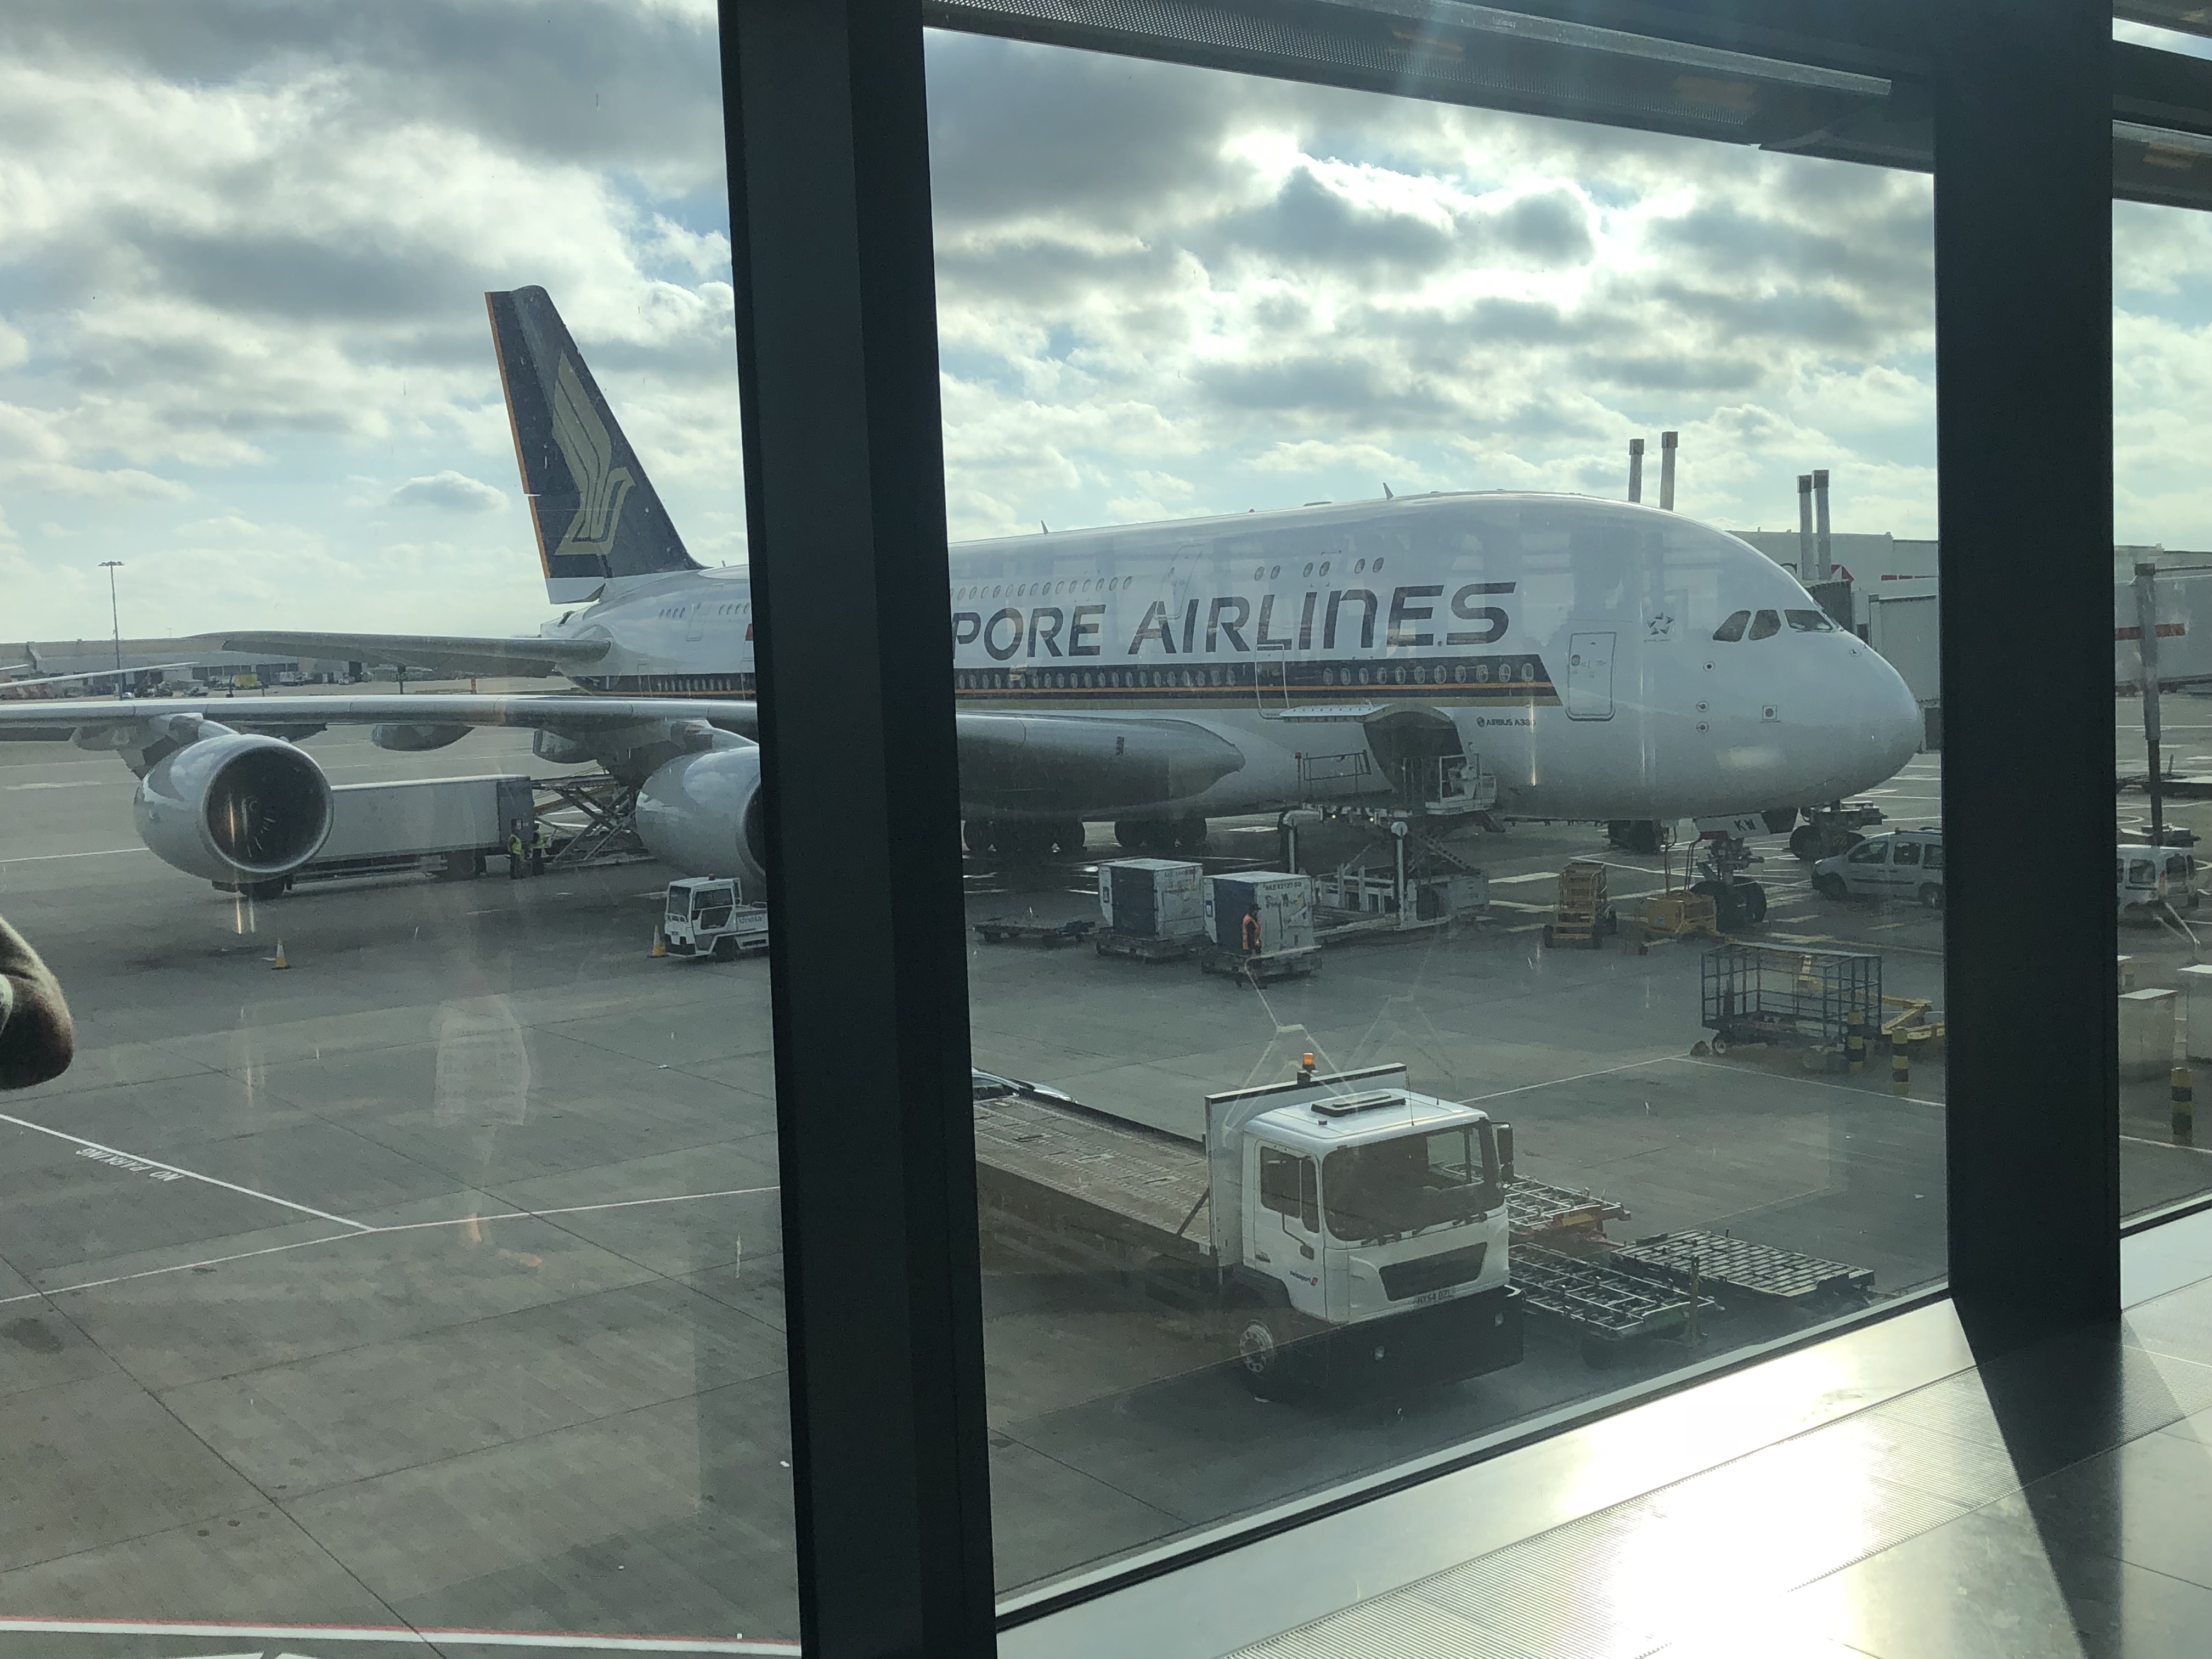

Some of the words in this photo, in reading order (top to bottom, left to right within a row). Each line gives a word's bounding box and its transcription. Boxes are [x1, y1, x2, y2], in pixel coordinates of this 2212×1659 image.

[1127, 582, 1516, 655] AIRLINES
[75, 1148, 153, 1171] PARKING
[149, 1170, 185, 1181] NO
